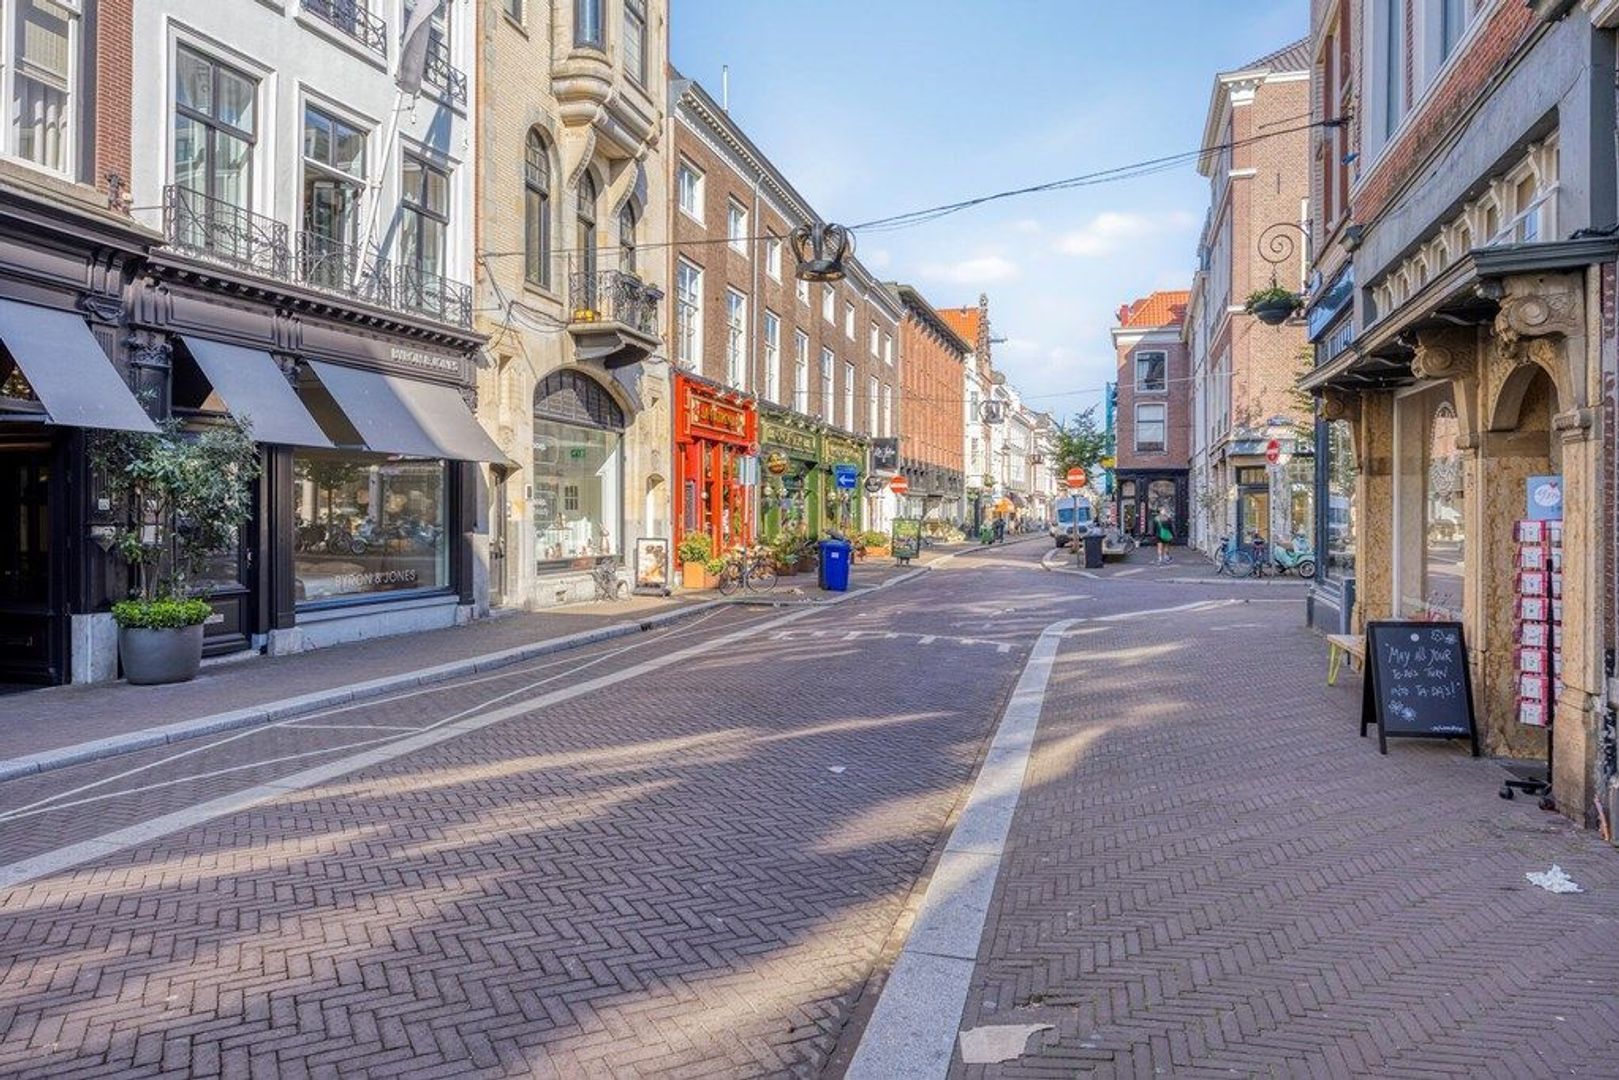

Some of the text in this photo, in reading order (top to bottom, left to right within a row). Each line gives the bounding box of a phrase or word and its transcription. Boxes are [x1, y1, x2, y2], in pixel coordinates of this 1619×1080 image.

[335, 569, 416, 586] BYRON & JONES
